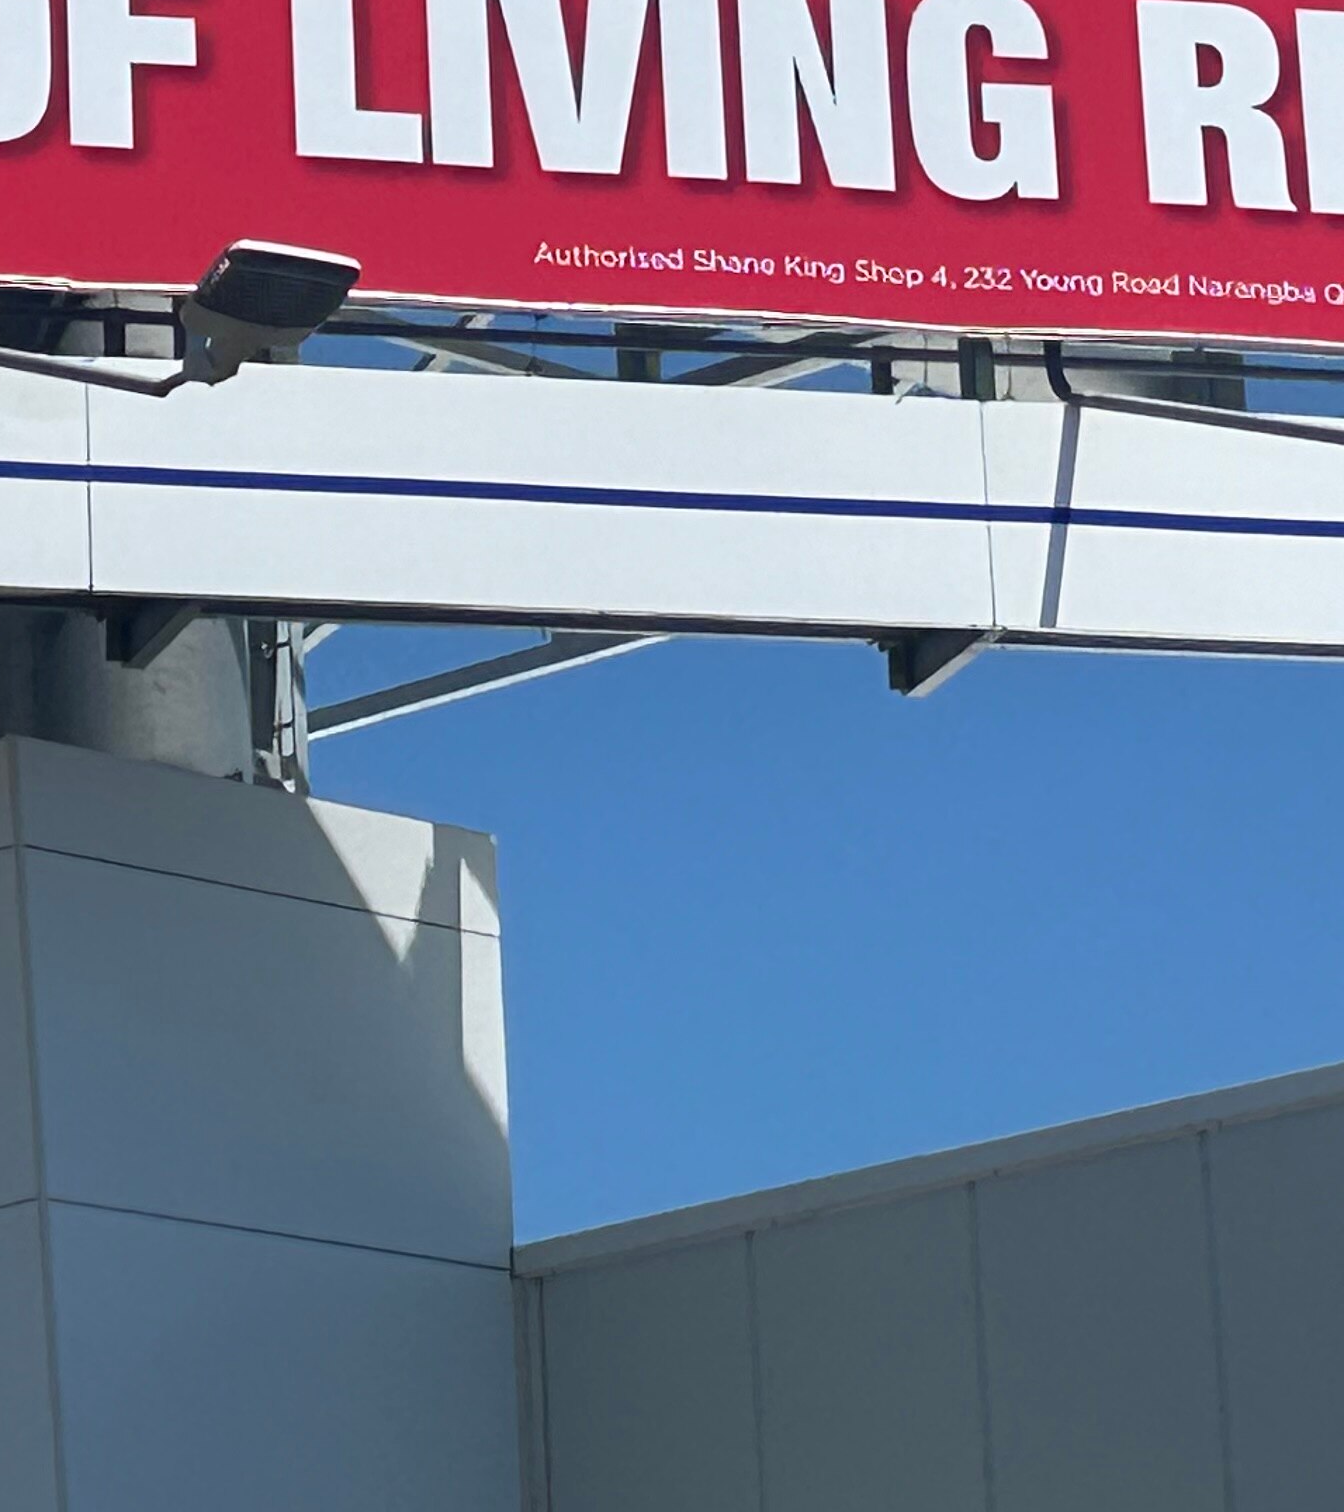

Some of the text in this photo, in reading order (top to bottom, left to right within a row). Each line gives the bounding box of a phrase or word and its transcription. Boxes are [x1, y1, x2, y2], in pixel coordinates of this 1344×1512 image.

[693, 249, 775, 276] Shane
[784, 255, 846, 284] King
[855, 259, 924, 288] Shop
[931, 265, 956, 290] 4,
[963, 266, 1013, 290] 232
[1020, 269, 1103, 296] Young
[1112, 271, 1181, 296] Road
[1189, 275, 1317, 306] Narangba
